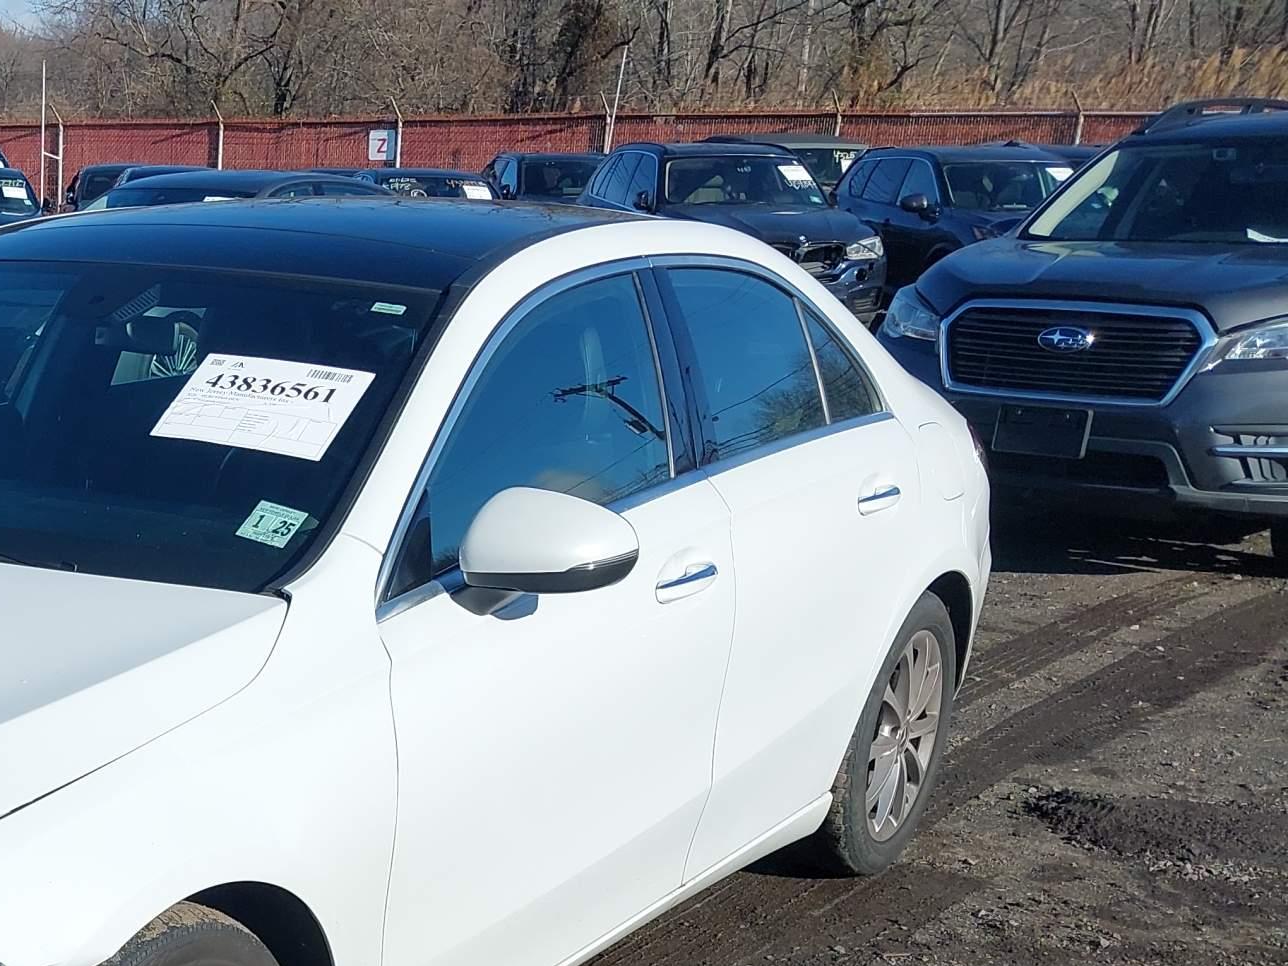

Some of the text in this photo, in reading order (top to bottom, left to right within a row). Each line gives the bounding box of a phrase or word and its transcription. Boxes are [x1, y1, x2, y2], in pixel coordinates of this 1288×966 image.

[376, 138, 387, 154] Z
[205, 372, 338, 405] 43836561
[252, 514, 265, 529] 1
[271, 520, 297, 537] 25
